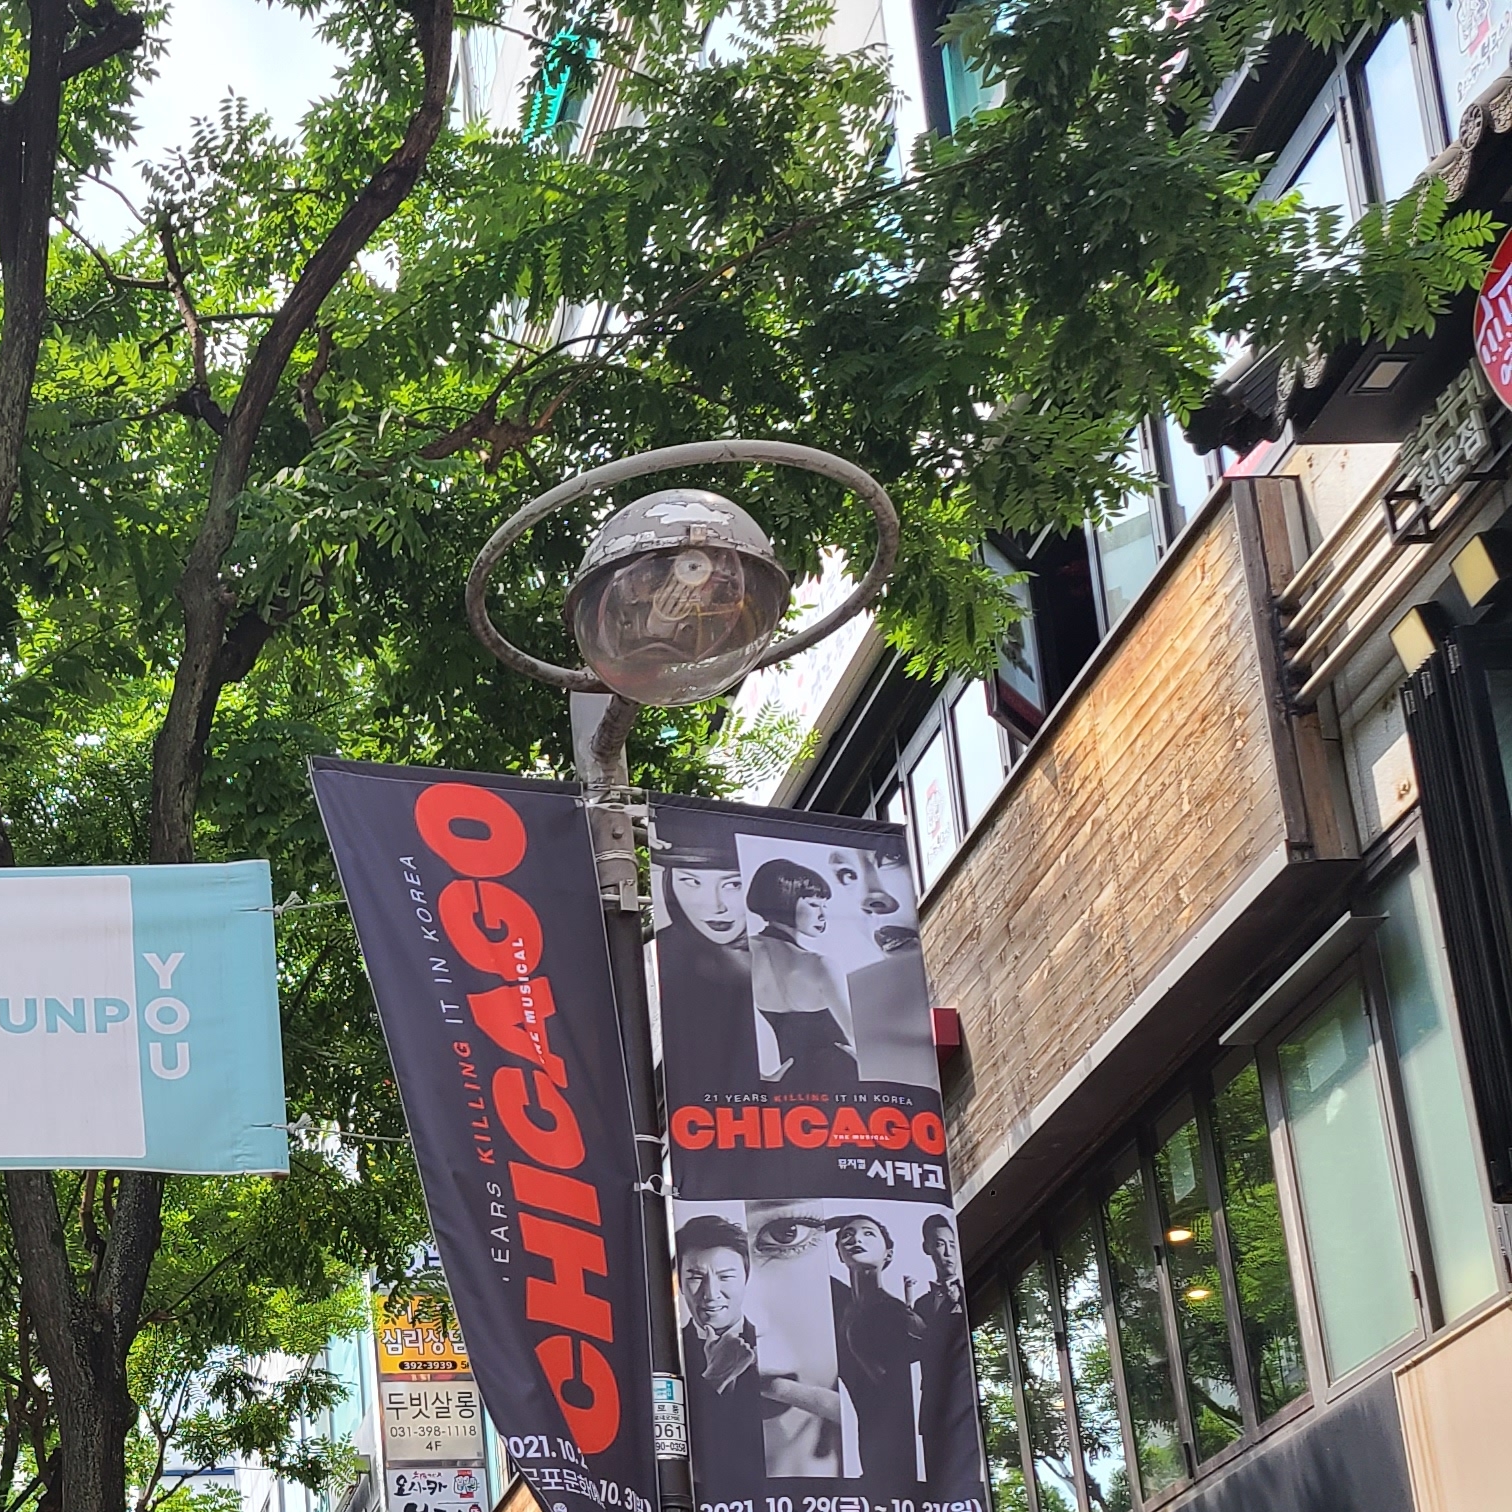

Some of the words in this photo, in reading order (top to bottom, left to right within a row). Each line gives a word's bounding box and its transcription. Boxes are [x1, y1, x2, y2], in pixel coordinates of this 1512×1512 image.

[399, 854, 442, 941] KOREA
[427, 956, 454, 985] IN
[511, 936, 539, 1026] MUSICAL
[443, 1000, 465, 1025] IT
[452, 1040, 496, 1165] KILLING
[703, 1093, 719, 1103] 21
[725, 1093, 768, 1104] YEARS
[774, 1093, 829, 1103] KILLING
[835, 1093, 847, 1103] IT
[853, 1094, 867, 1103] IN
[873, 1094, 913, 1107] KOREA
[414, 781, 623, 1456] CHICAGO
[670, 1105, 947, 1157] CHICAGO
[833, 1133, 850, 1141] THE
[852, 1134, 891, 1142] MUSICAL
[837, 1158, 866, 1170] 뮤지컬
[866, 1158, 947, 1191] 시카고
[487, 1182, 512, 1284] EARS
[403, 1361, 454, 1371] 392-3939
[385, 1390, 478, 1421] 두빗살롱
[390, 1425, 477, 1439] 031-398-1118
[425, 1440, 443, 1452] 4F
[393, 1473, 448, 1497] 오사카
